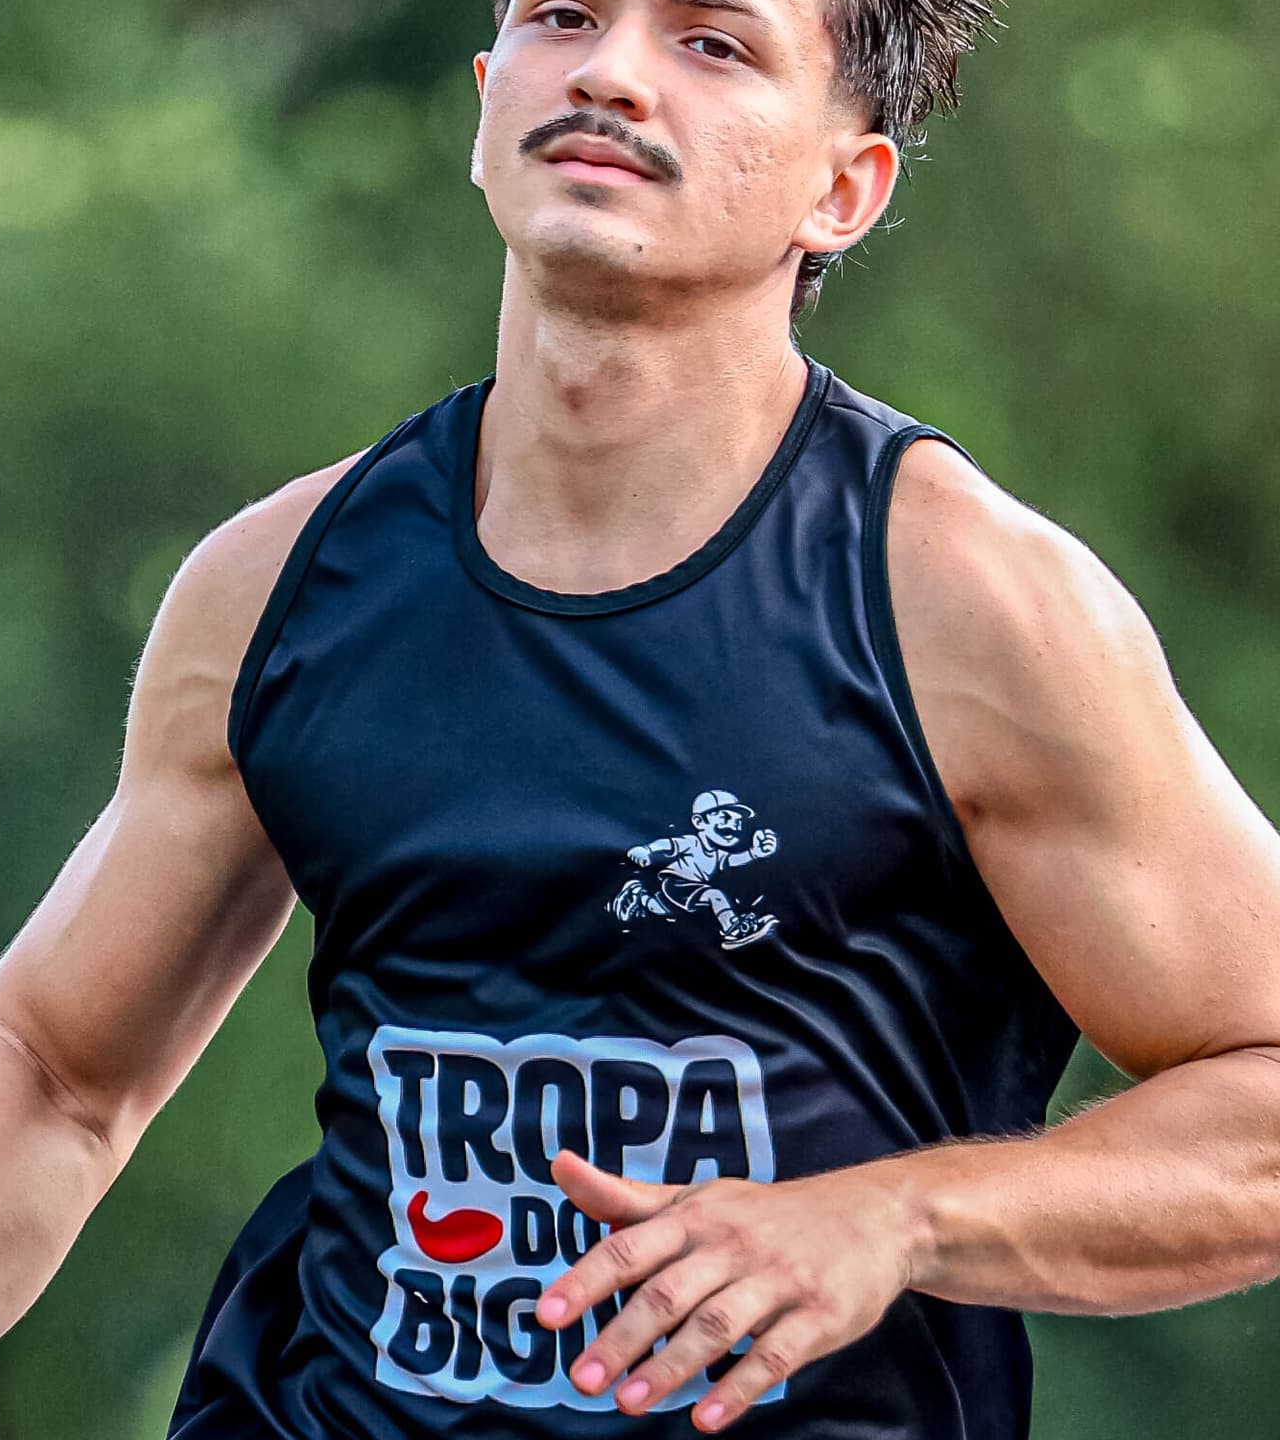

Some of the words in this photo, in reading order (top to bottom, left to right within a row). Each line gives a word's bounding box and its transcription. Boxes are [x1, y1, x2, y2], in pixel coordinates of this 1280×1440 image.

[381, 1050, 751, 1185] TROPA
[510, 1195, 602, 1266] DO
[386, 1268, 746, 1385] BIG
